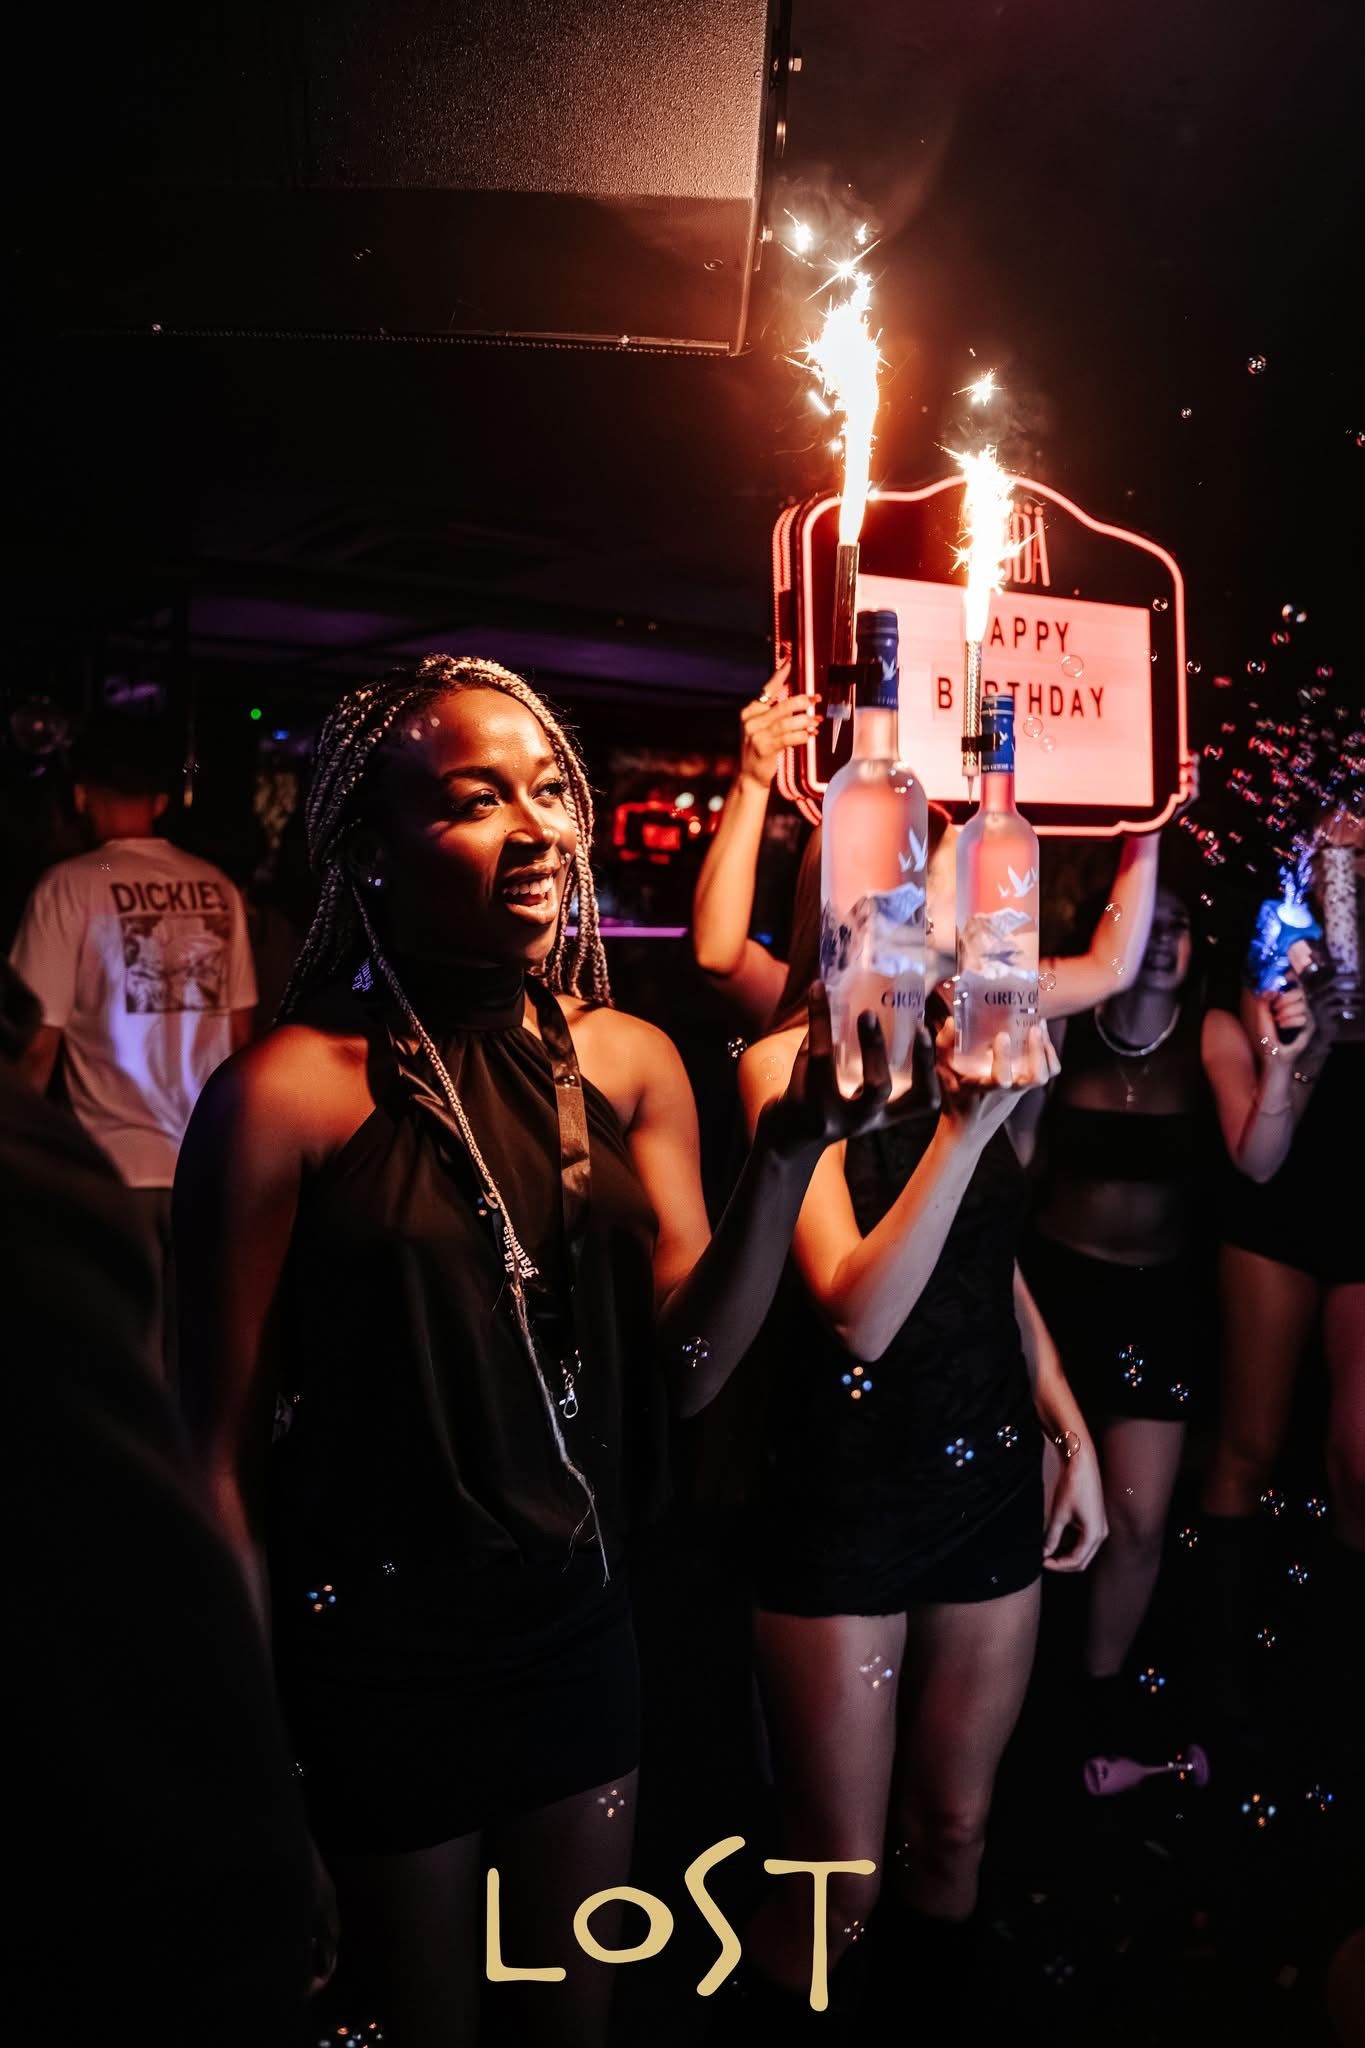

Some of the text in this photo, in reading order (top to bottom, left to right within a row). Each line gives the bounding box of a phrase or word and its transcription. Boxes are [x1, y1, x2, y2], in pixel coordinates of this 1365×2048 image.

[990, 616, 1069, 653] APPY
[937, 677, 1104, 718] BTHDAY
[984, 989, 1024, 1006] GREY
